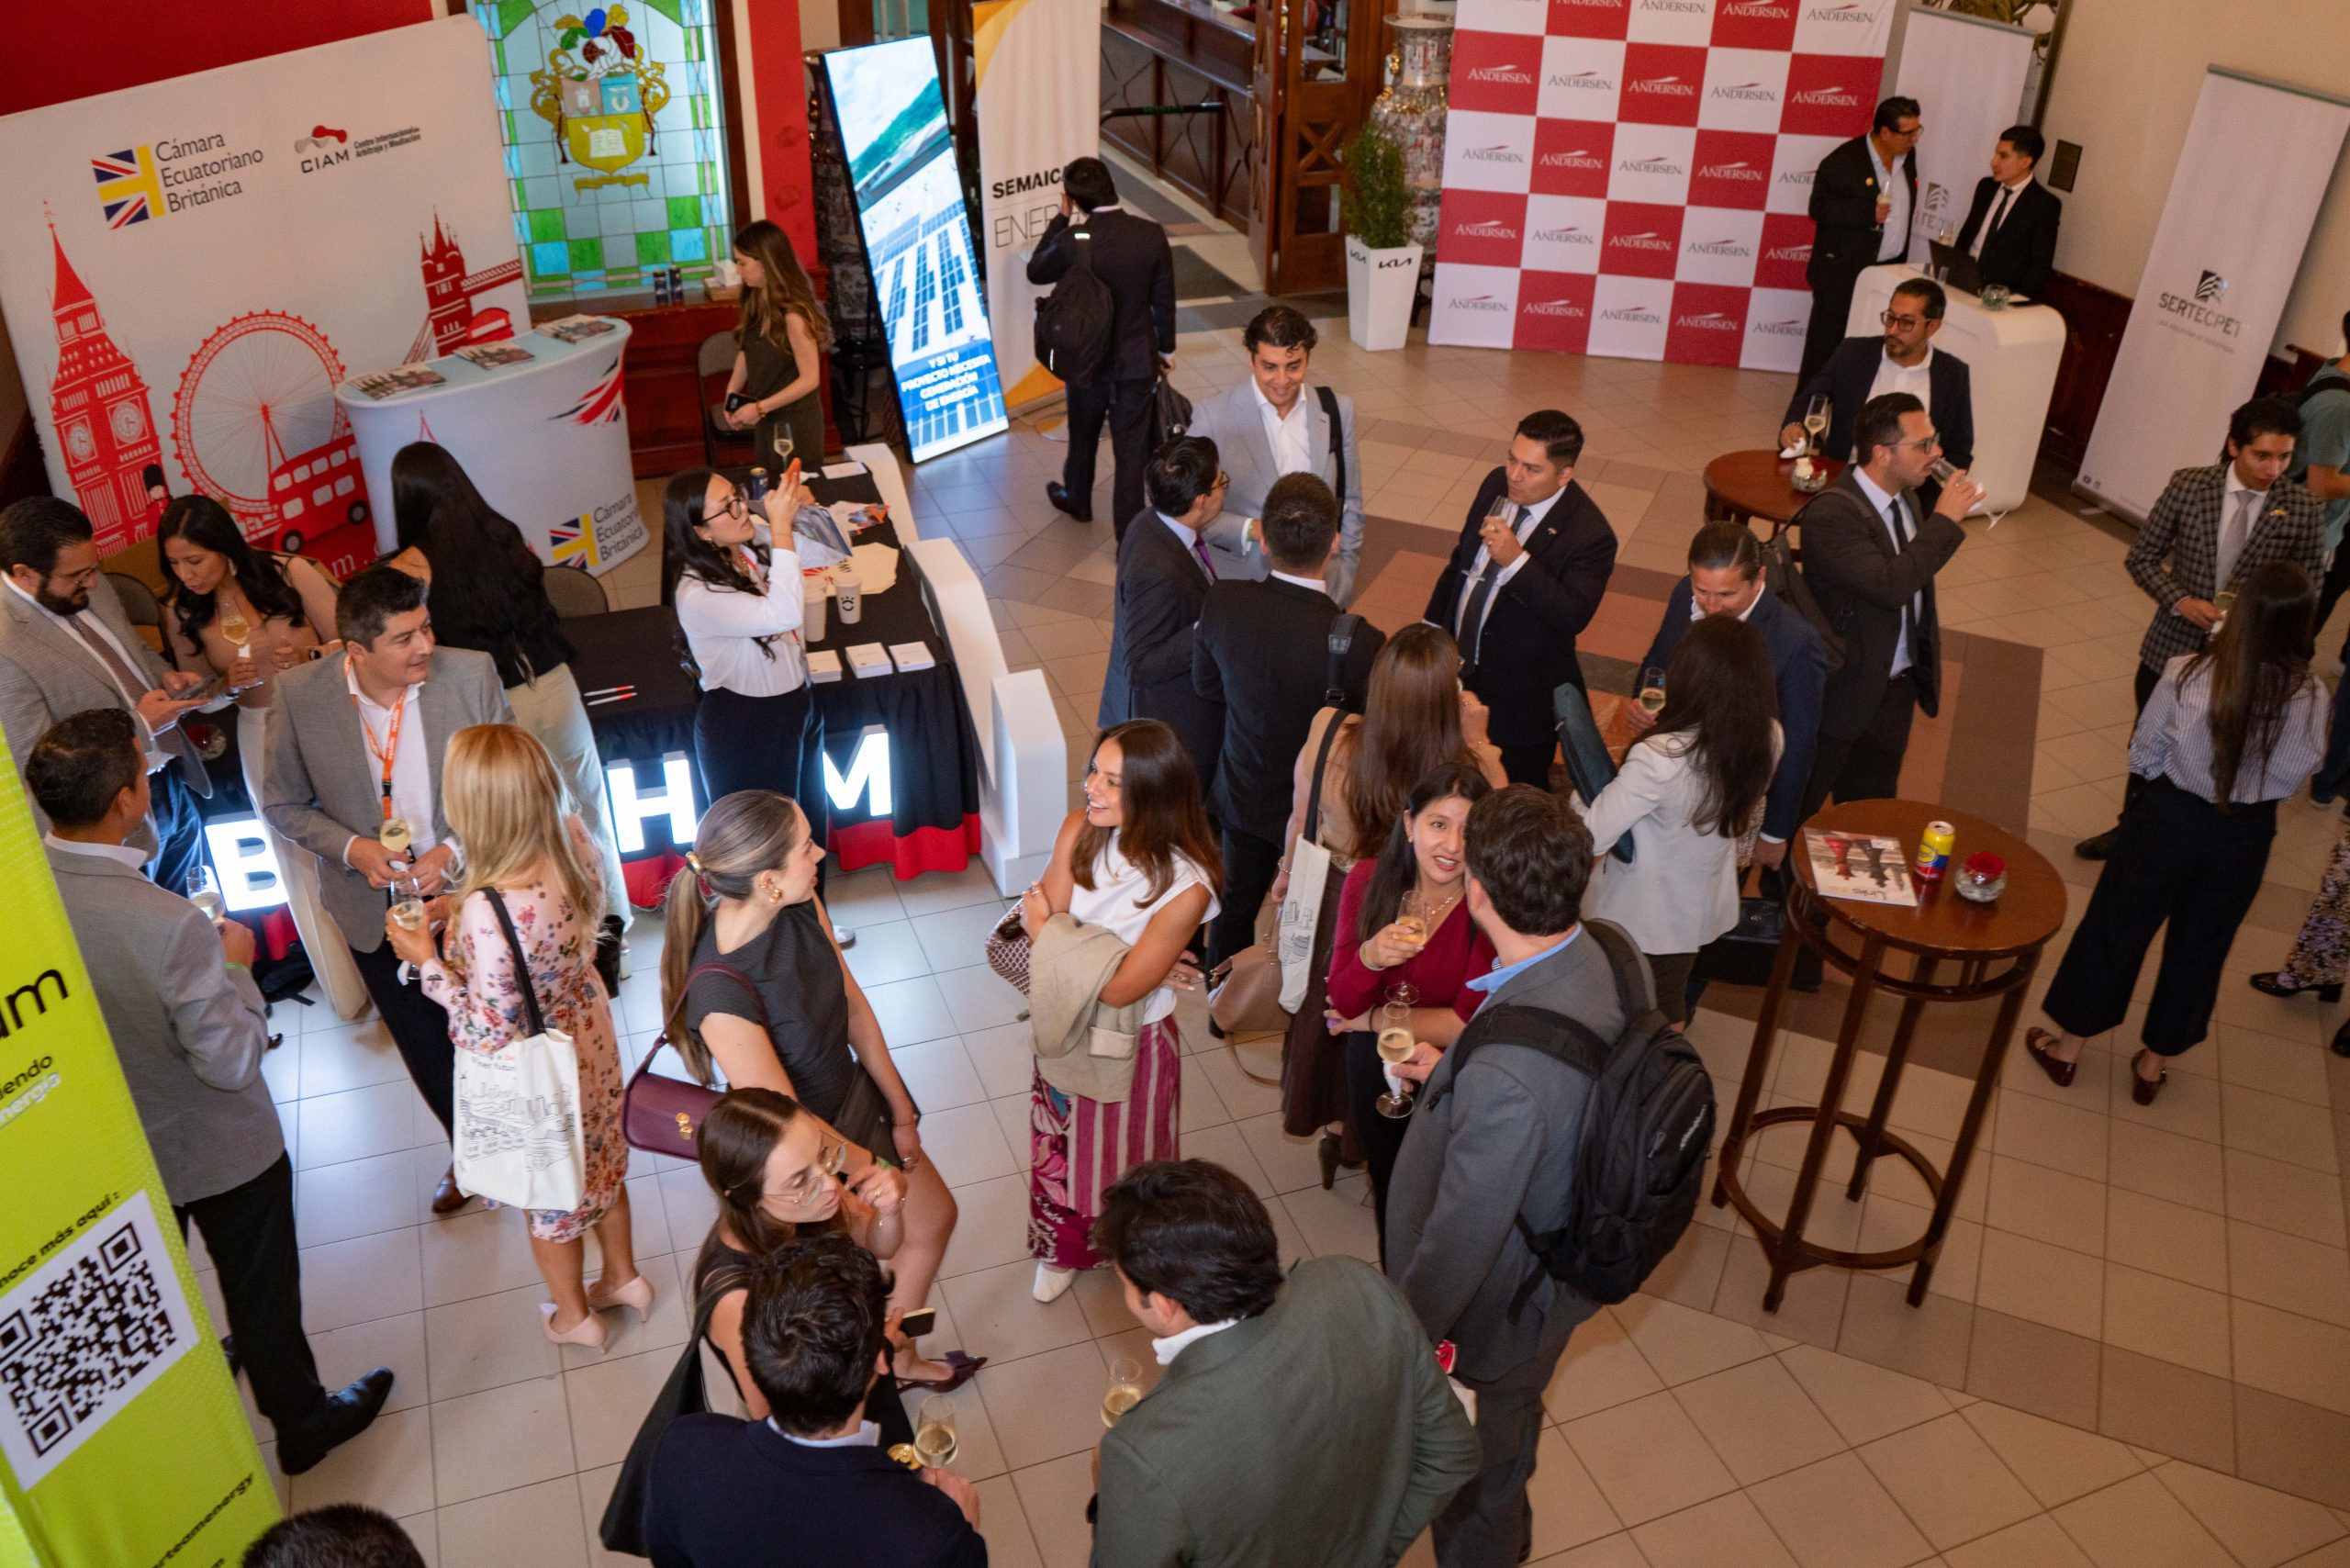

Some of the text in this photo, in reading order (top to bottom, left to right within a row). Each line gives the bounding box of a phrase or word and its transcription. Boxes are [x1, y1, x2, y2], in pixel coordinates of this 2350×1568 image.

[155, 134, 226, 162] Cámara
[301, 149, 350, 174] CIAM
[161, 150, 264, 188] Ecuatoriano
[992, 168, 1063, 199] SEMAIC
[166, 181, 243, 213] Británica
[1765, 248, 1811, 262] ANDERS
[1753, 322, 1807, 337] ANDERSE
[2158, 292, 2242, 338] SERTECPET
